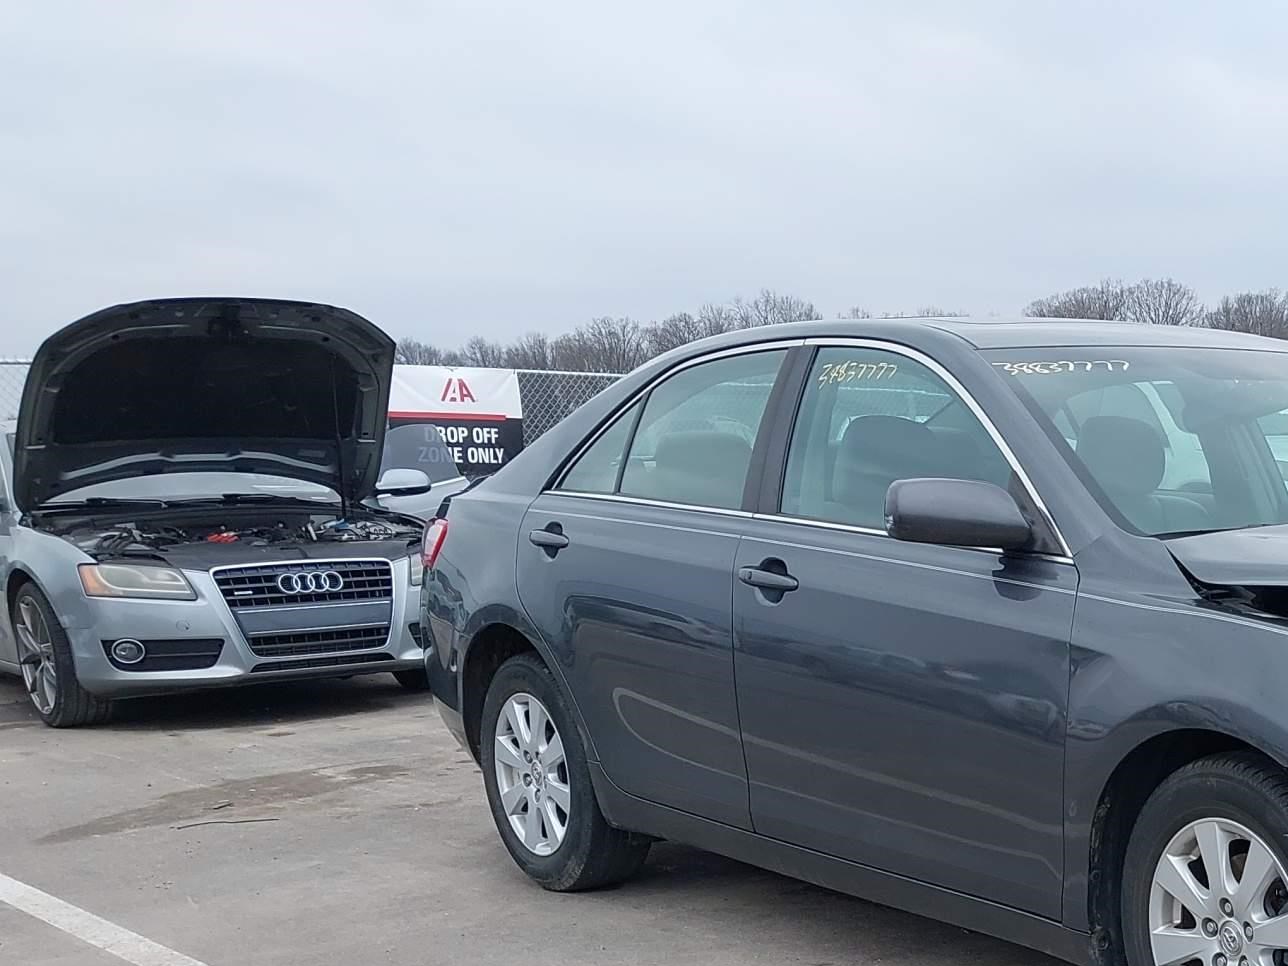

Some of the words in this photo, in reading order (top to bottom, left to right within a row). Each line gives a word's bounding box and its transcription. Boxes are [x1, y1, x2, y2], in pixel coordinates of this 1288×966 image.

[424, 426, 468, 443] DROP
[472, 427, 499, 444] OFF
[418, 446, 463, 463] ZONE
[467, 447, 504, 464] ONLY
